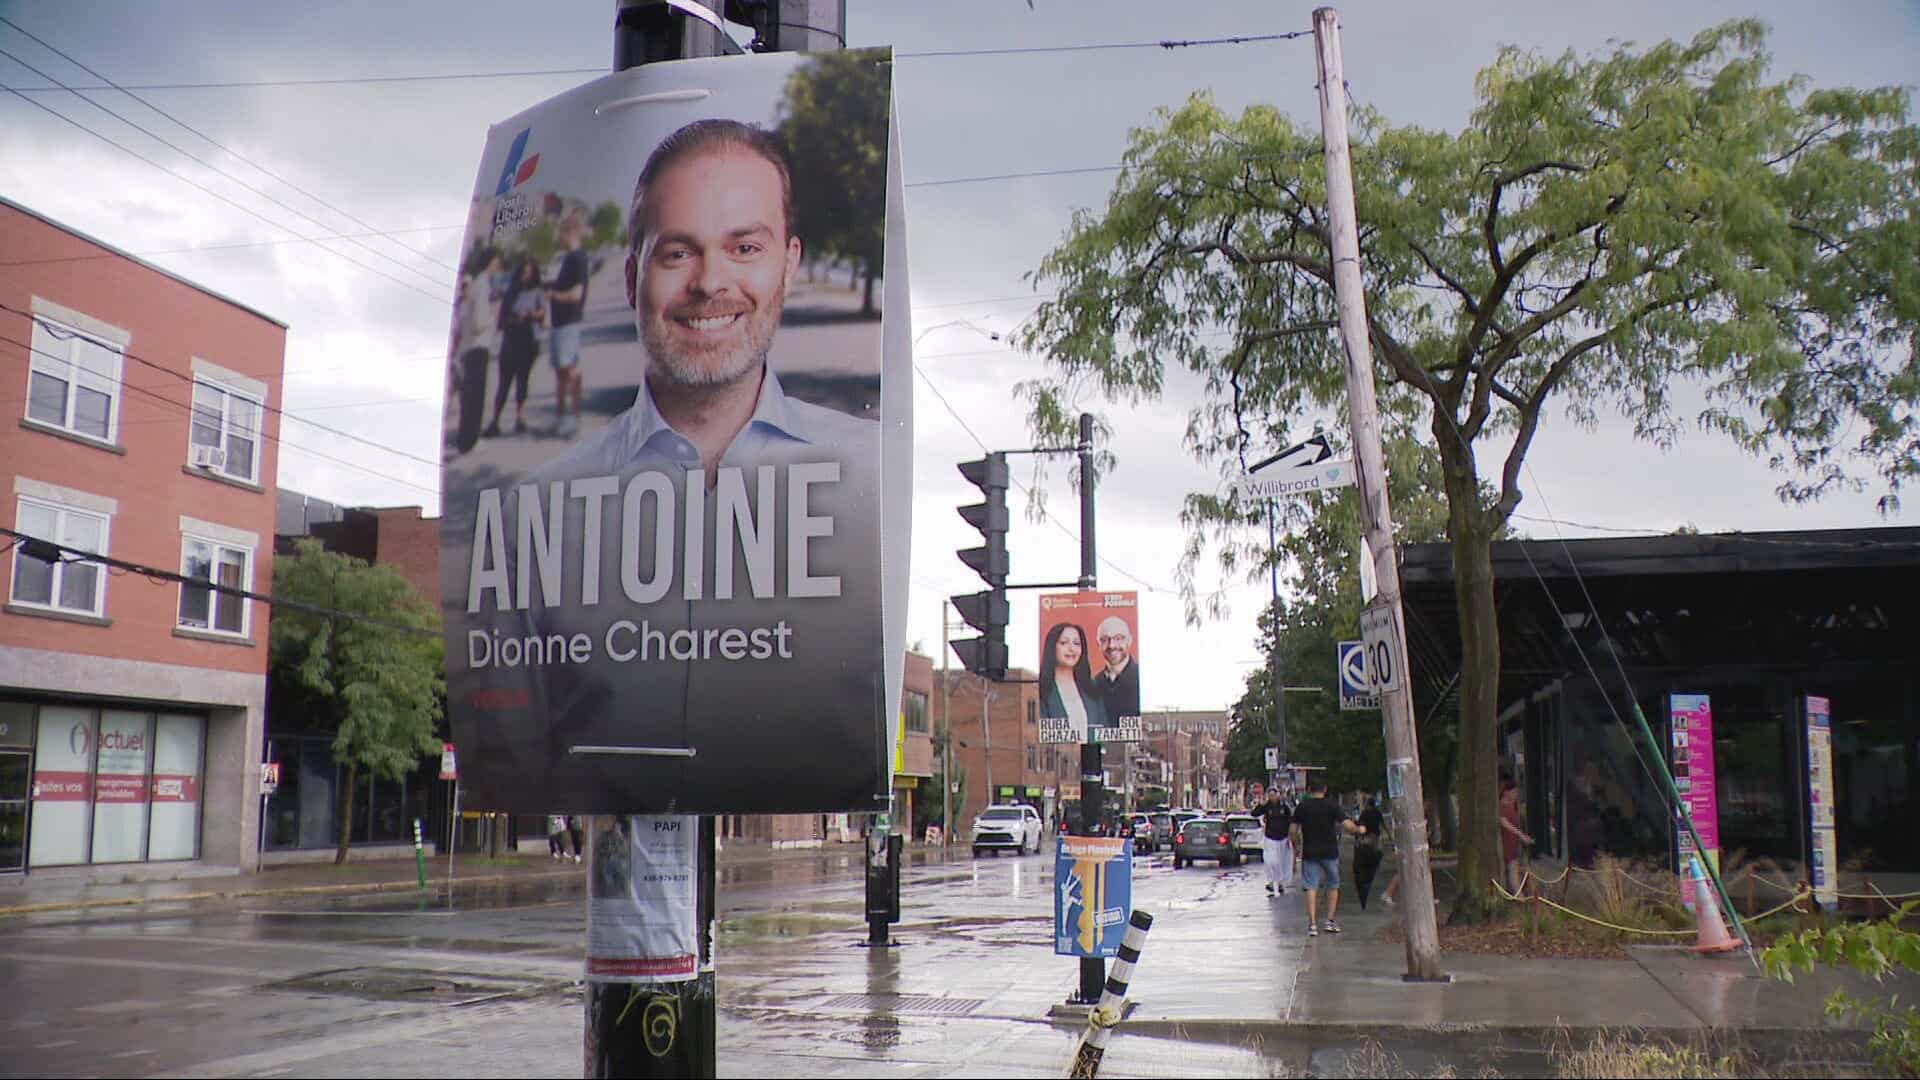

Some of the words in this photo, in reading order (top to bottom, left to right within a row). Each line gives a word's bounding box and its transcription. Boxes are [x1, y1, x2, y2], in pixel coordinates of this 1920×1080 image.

[1246, 474, 1319, 496] Willibrord
[467, 462, 841, 613] ANTOINE
[468, 629, 593, 668] Dionne
[605, 619, 793, 662] Charest
[1369, 640, 1391, 685] 30
[1040, 719, 1070, 730] RUBA
[97, 730, 145, 751] actuel
[1041, 730, 1082, 742] GHAZAL
[1096, 729, 1141, 741] ZANETTI
[65, 783, 83, 793] vos
[654, 821, 681, 832] PAPI
